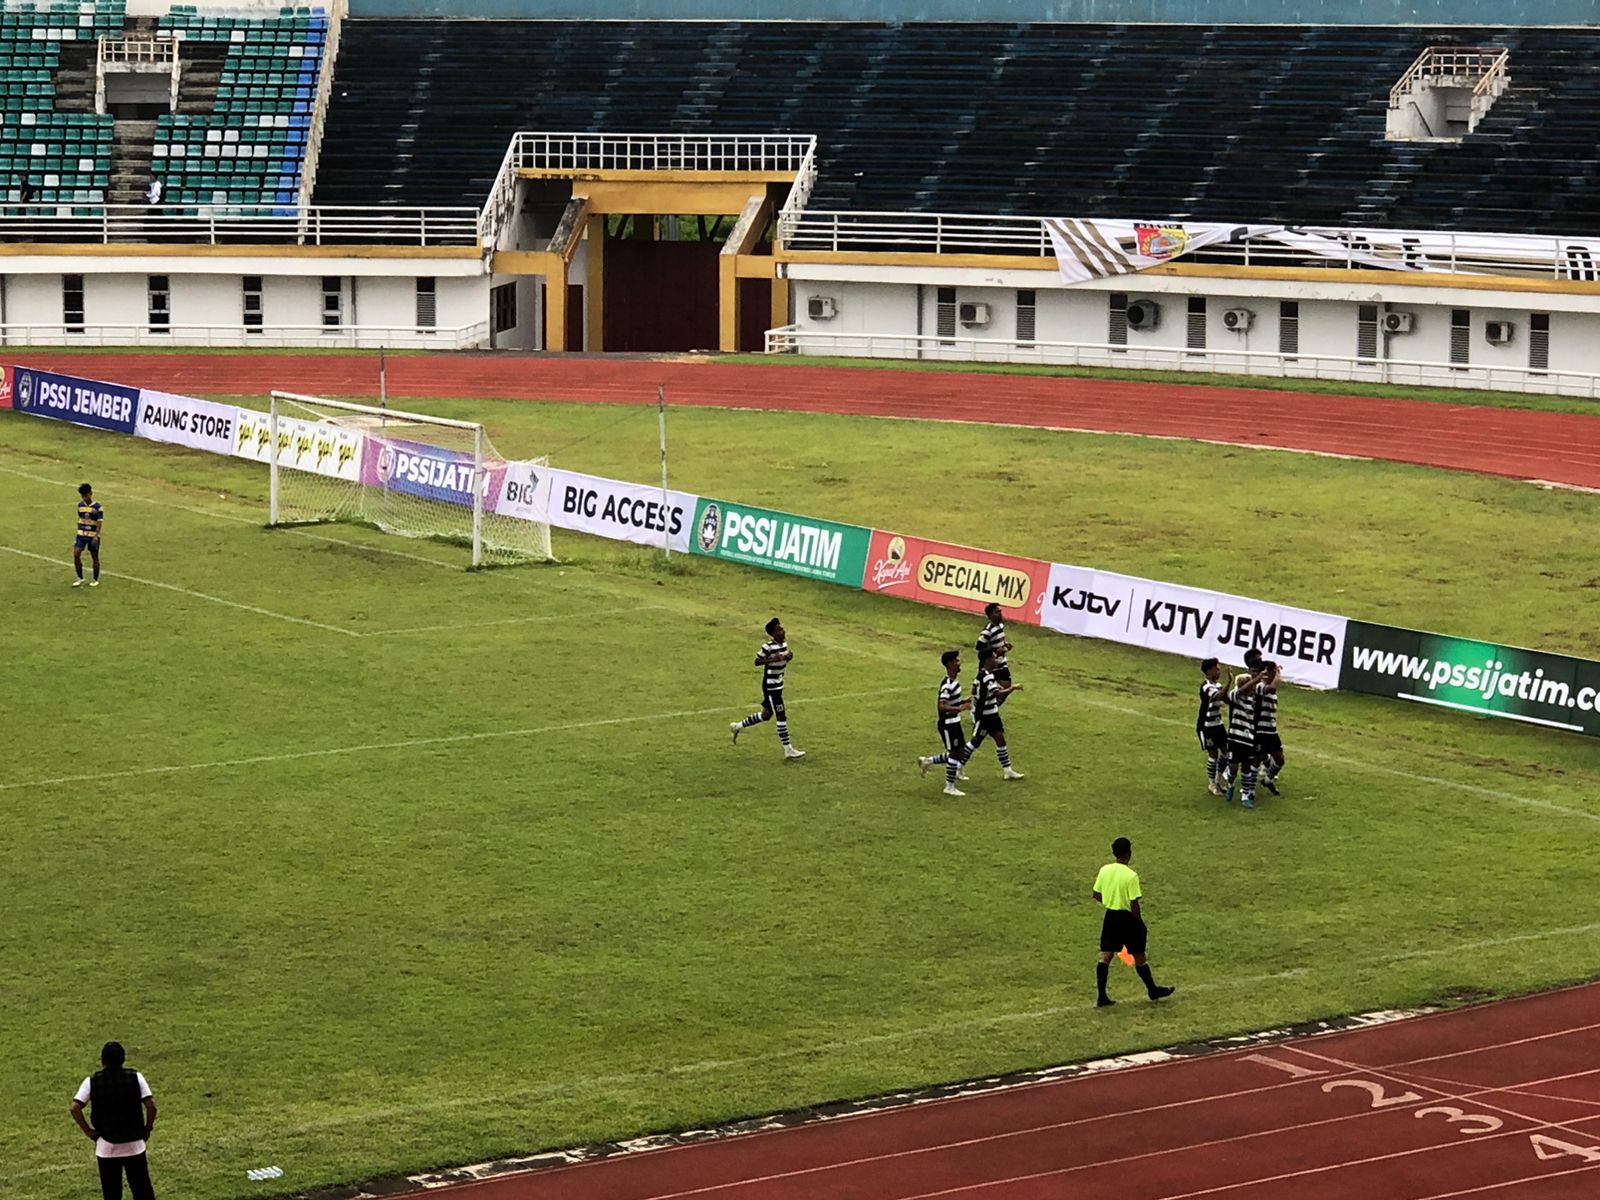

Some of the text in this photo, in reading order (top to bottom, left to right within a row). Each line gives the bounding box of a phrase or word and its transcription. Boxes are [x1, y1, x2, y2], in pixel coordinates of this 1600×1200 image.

[40, 381, 131, 423] PSSI JEMBER
[143, 404, 188, 431] RAUNG
[191, 413, 231, 440] STORE
[563, 485, 684, 535] BIG ACCESS
[923, 560, 1026, 601] SPECIAL MIX
[1142, 599, 1337, 666] KJTV JEMBER
[1235, 1053, 1329, 1079] 1
[1321, 1079, 1423, 1108] 2
[1414, 1106, 1503, 1134] 3
[1529, 1134, 1600, 1163] 4
